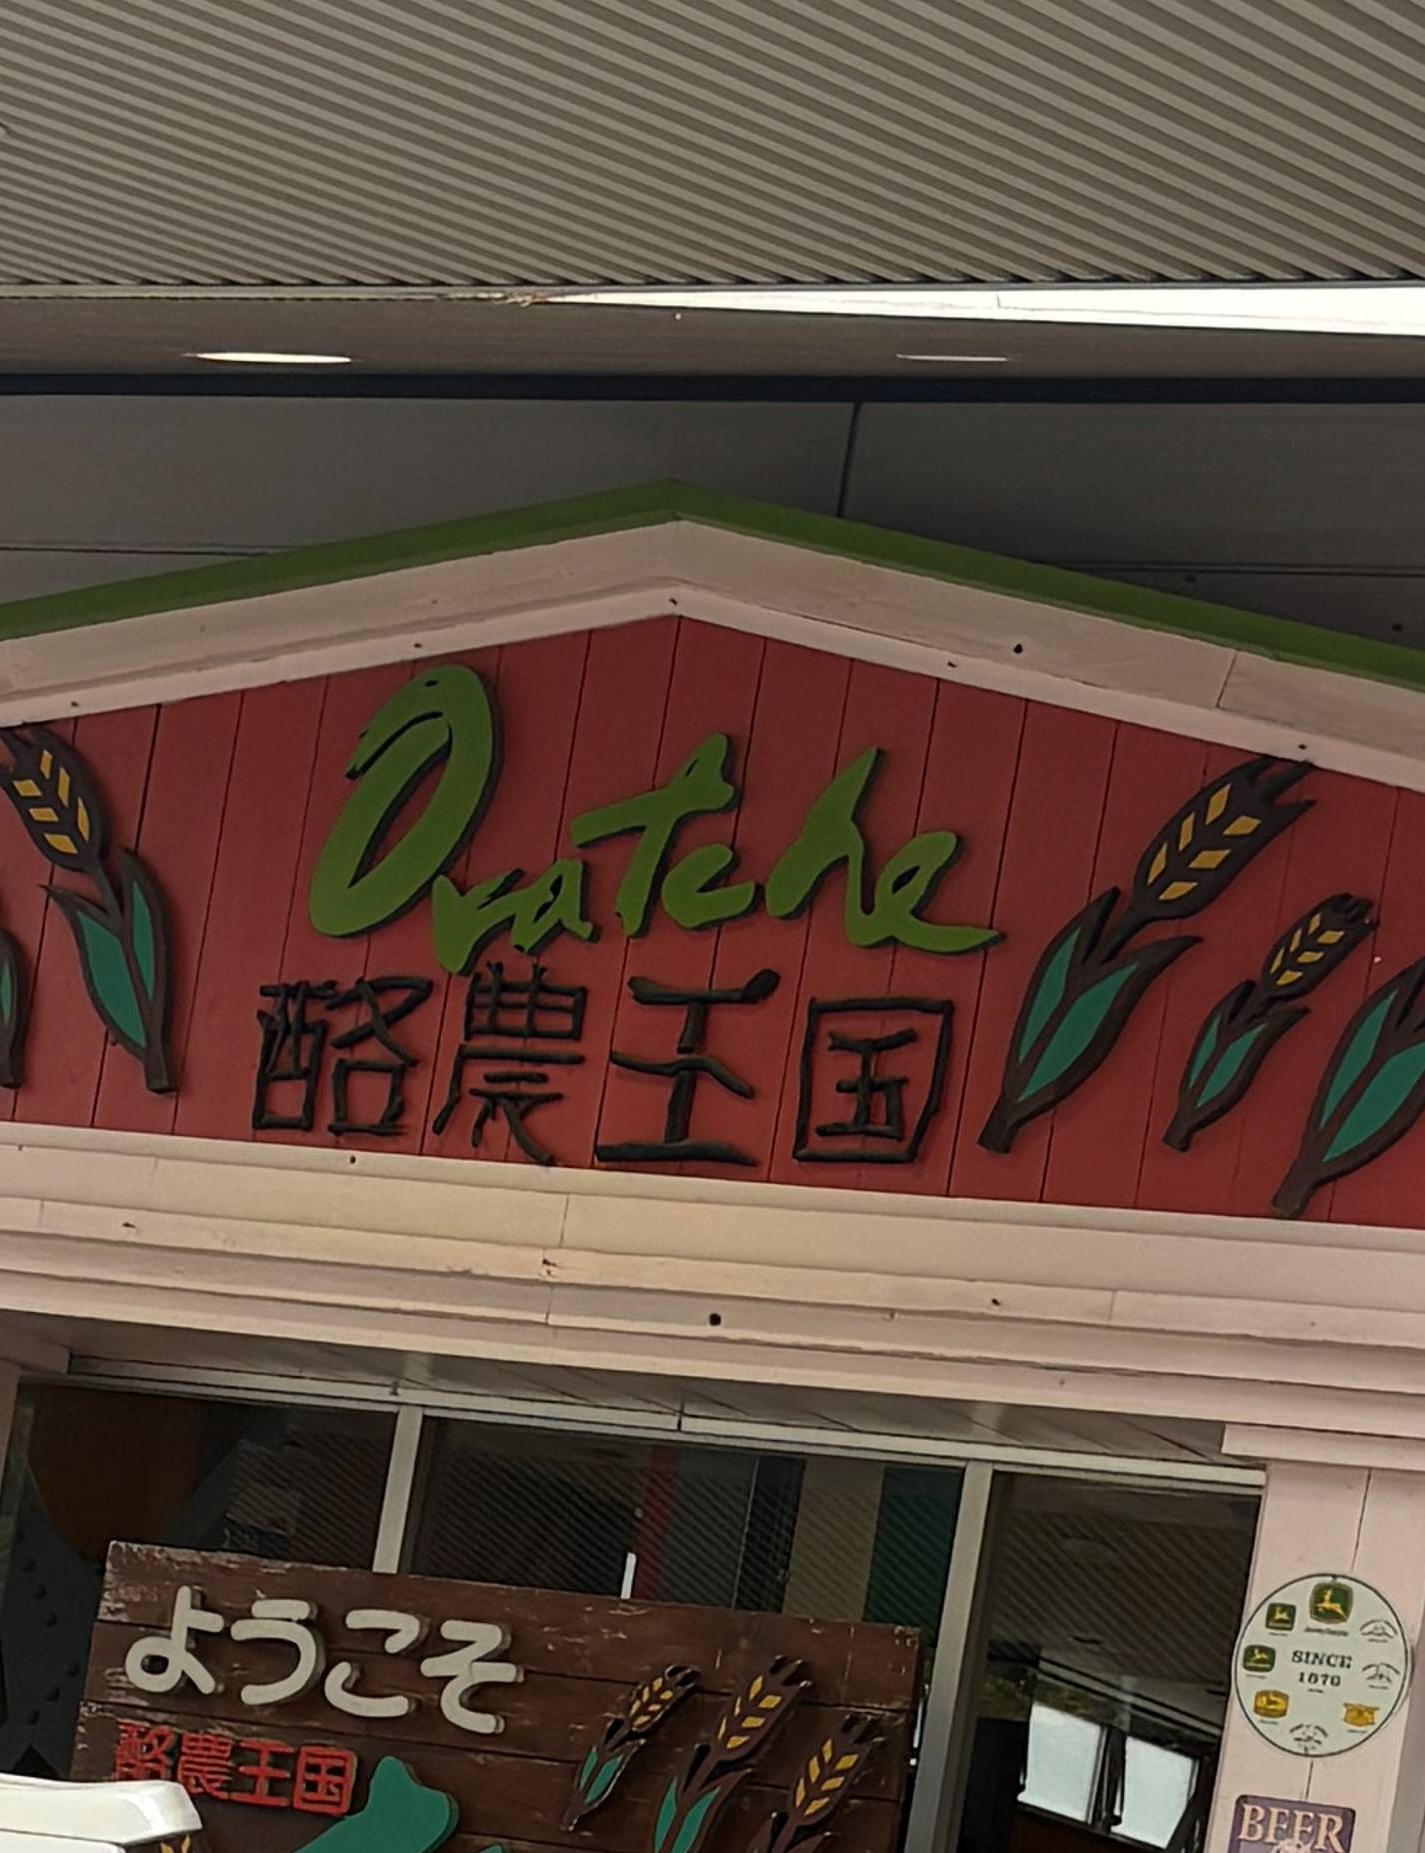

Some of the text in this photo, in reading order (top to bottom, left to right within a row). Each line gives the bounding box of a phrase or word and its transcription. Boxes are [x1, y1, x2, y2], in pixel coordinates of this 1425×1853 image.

[309, 664, 1003, 973] Oratche
[251, 960, 956, 1166] 酪農王国
[124, 1585, 525, 1735] ようこそ
[1291, 1649, 1353, 1669] SINCE
[113, 1719, 358, 1819] 酪農王国
